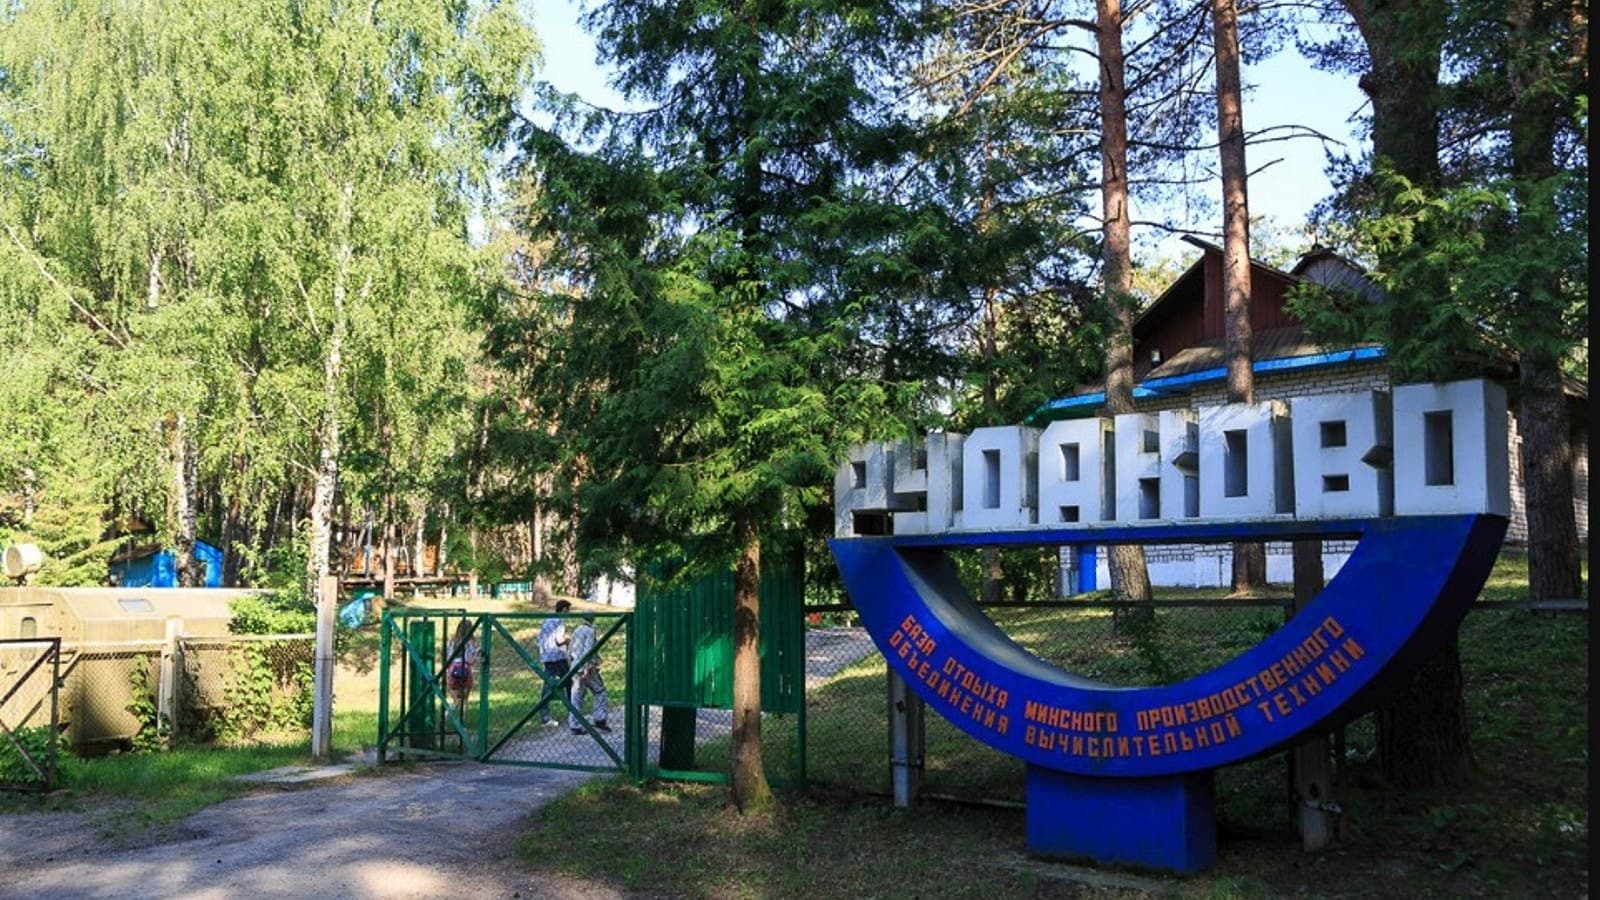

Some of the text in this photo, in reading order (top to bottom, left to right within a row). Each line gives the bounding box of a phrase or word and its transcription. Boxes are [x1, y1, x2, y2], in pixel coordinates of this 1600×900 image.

[888, 629, 1366, 758] ОБЪЕДИНЕНИЯ ВЫЧИСЛИТЕЛЬНОЙ ТЕХНИКИ
[901, 614, 1345, 732] БАЗА ОТДЫХА МИНСКОГО ПРОИЗВОДСТВЕННОГО
